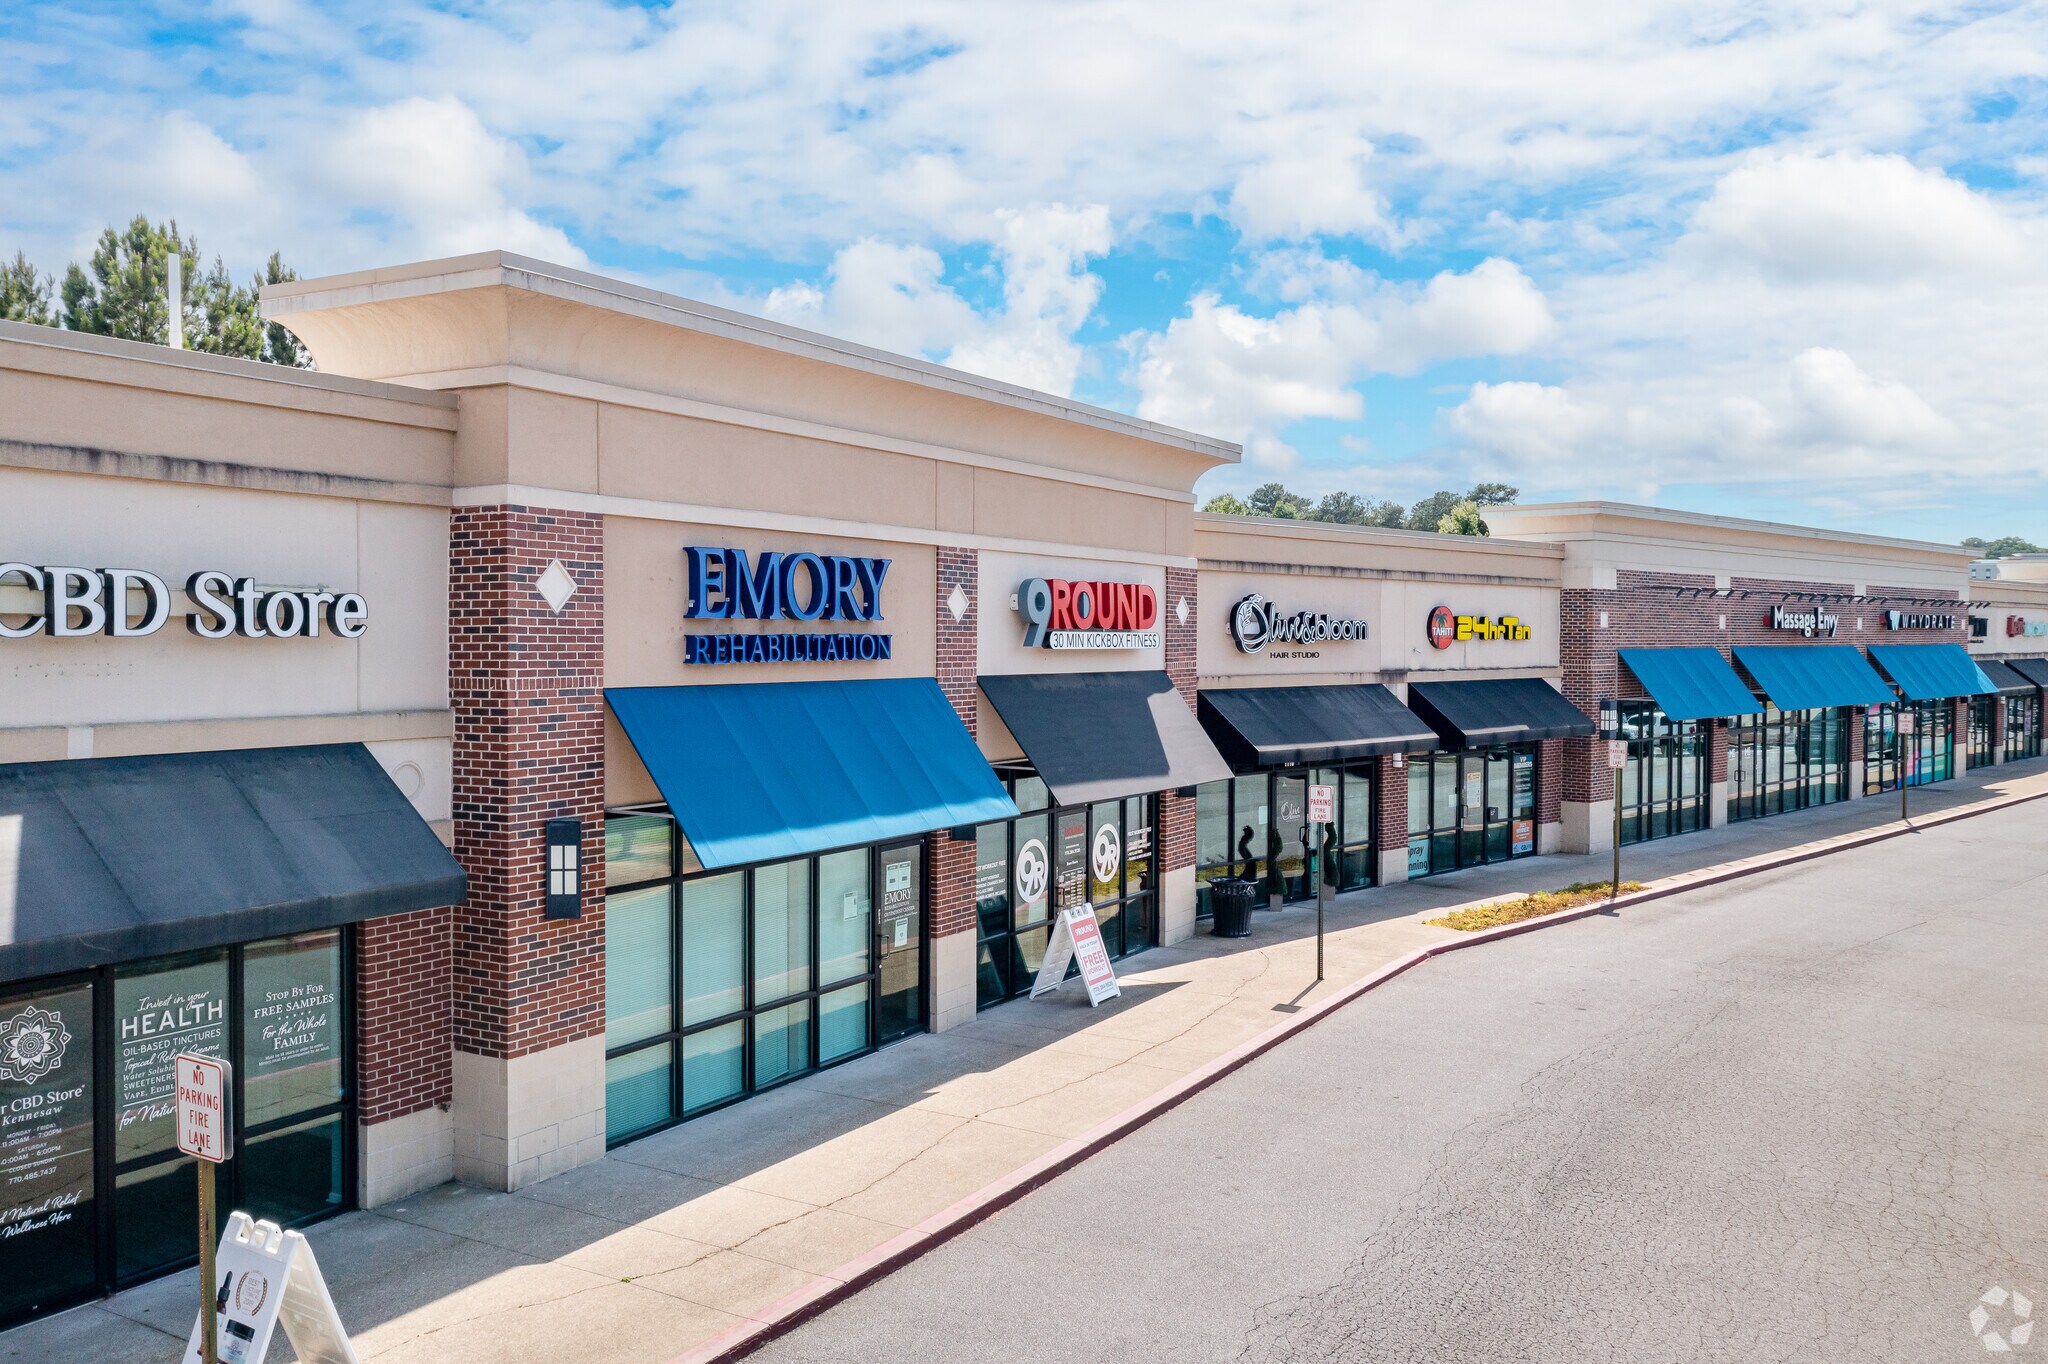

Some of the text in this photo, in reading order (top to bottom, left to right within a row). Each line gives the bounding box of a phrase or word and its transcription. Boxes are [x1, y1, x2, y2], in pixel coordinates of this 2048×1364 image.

[683, 547, 892, 621] EMORY
[0, 562, 369, 639] CBD Store
[1432, 627, 1453, 636] TAHITI
[1771, 605, 1839, 638] Massage Envy
[1901, 615, 1956, 629] WHYDRATE
[683, 634, 893, 664] REHABILITATION
[1053, 633, 1157, 648] 30 MIN KICKBOX FITNESS
[1310, 798, 1332, 807] PARKING
[1316, 789, 1325, 797] NO
[1408, 860, 1428, 871] nning
[884, 887, 912, 905] EMORY
[1082, 950, 1105, 968] FREE
[137, 991, 209, 1012] Invest in your
[254, 993, 335, 1019] FREE SAMPLES
[121, 999, 223, 1039] HEALTH
[262, 1013, 327, 1041] For the Whole
[123, 1028, 221, 1057] OIL-BASED TINCTURES
[124, 1053, 157, 1074] Topical
[157, 1046, 185, 1064] Reli
[123, 1062, 175, 1082] Water Soluble
[123, 1072, 176, 1091] SWEETENERS
[192, 1069, 205, 1086] NO
[150, 1083, 175, 1095] EDIBL
[180, 1086, 219, 1111] PARKING
[11, 1094, 44, 1112] CBD
[46, 1087, 83, 1104] Store
[2, 1105, 63, 1126] Kennesaw
[119, 1102, 176, 1131] for Natur
[189, 1109, 209, 1129] FIRE
[6, 1128, 32, 1139] MONDAY
[188, 1129, 211, 1150] LANE
[17, 1142, 48, 1154] SATURDAY
[36, 1145, 61, 1156] 6:00PM
[8, 1166, 57, 1185] 770.485.7437
[9, 1198, 51, 1220] Natural
[51, 1190, 83, 1209] Relief
[2, 1210, 72, 1238] Wellness Here
